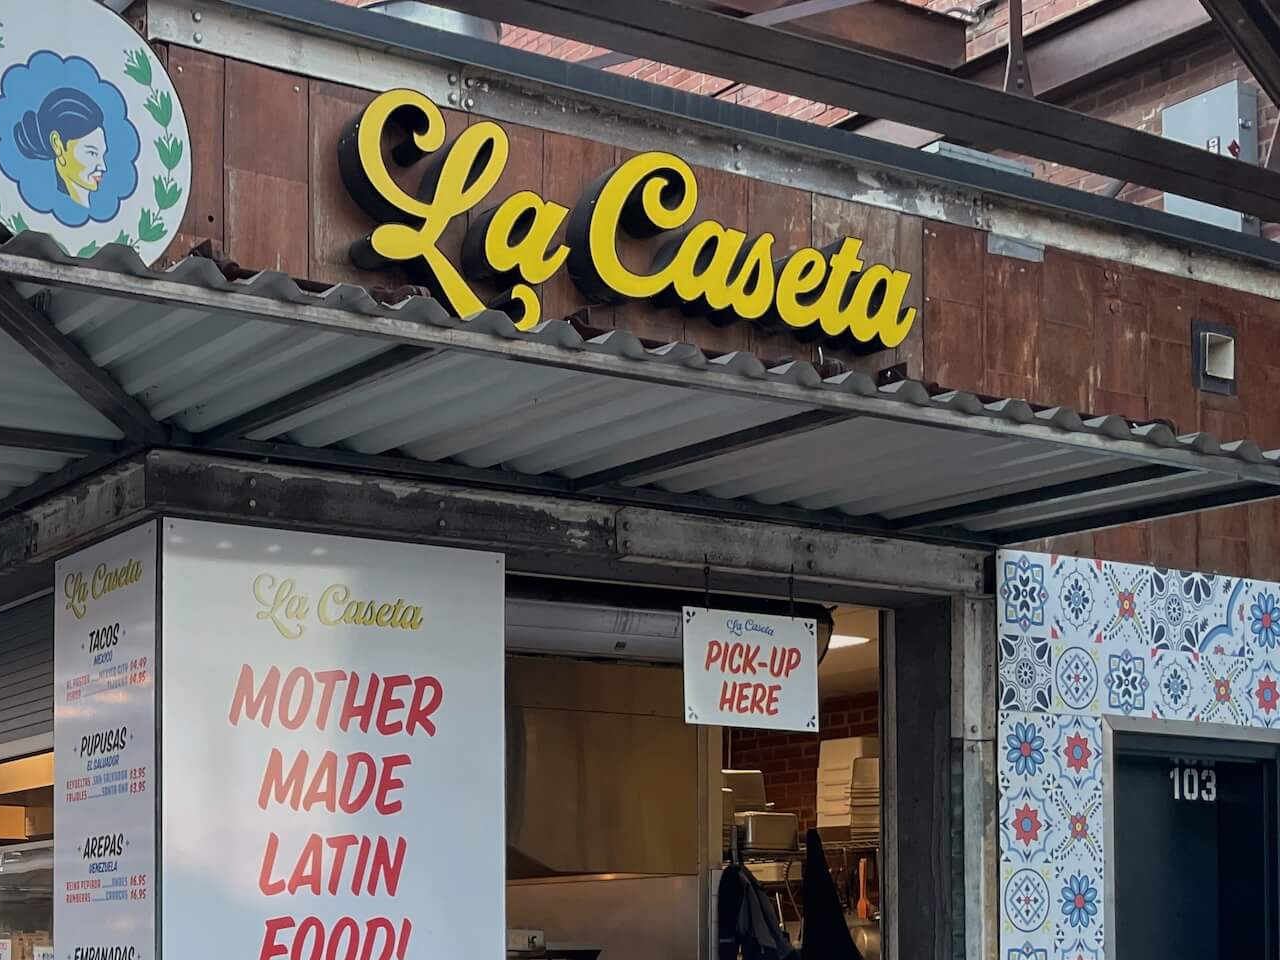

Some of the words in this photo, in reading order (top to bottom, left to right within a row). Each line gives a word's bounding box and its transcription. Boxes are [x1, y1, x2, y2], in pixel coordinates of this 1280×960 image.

[356, 87, 571, 331] La
[589, 150, 918, 349] Caseta
[64, 573, 88, 620] La
[91, 558, 142, 600] Caseta
[253, 573, 308, 640] La
[317, 583, 424, 631] Caseta
[88, 622, 120, 654] TACOS
[744, 619, 775, 637] Caseta
[93, 650, 113, 665] MEXICO
[704, 639, 802, 679] PICK-UP
[228, 662, 444, 738] MOTHER
[718, 680, 783, 716] HERE
[80, 726, 128, 757] PUPUSAS
[87, 758, 94, 771] EL
[94, 754, 120, 770] SALVADOR
[257, 747, 412, 816] MADE
[1170, 767, 1217, 801] 103
[82, 832, 124, 859] AREPAS
[88, 860, 118, 874] VENEZUELA
[257, 831, 408, 897] LATIN
